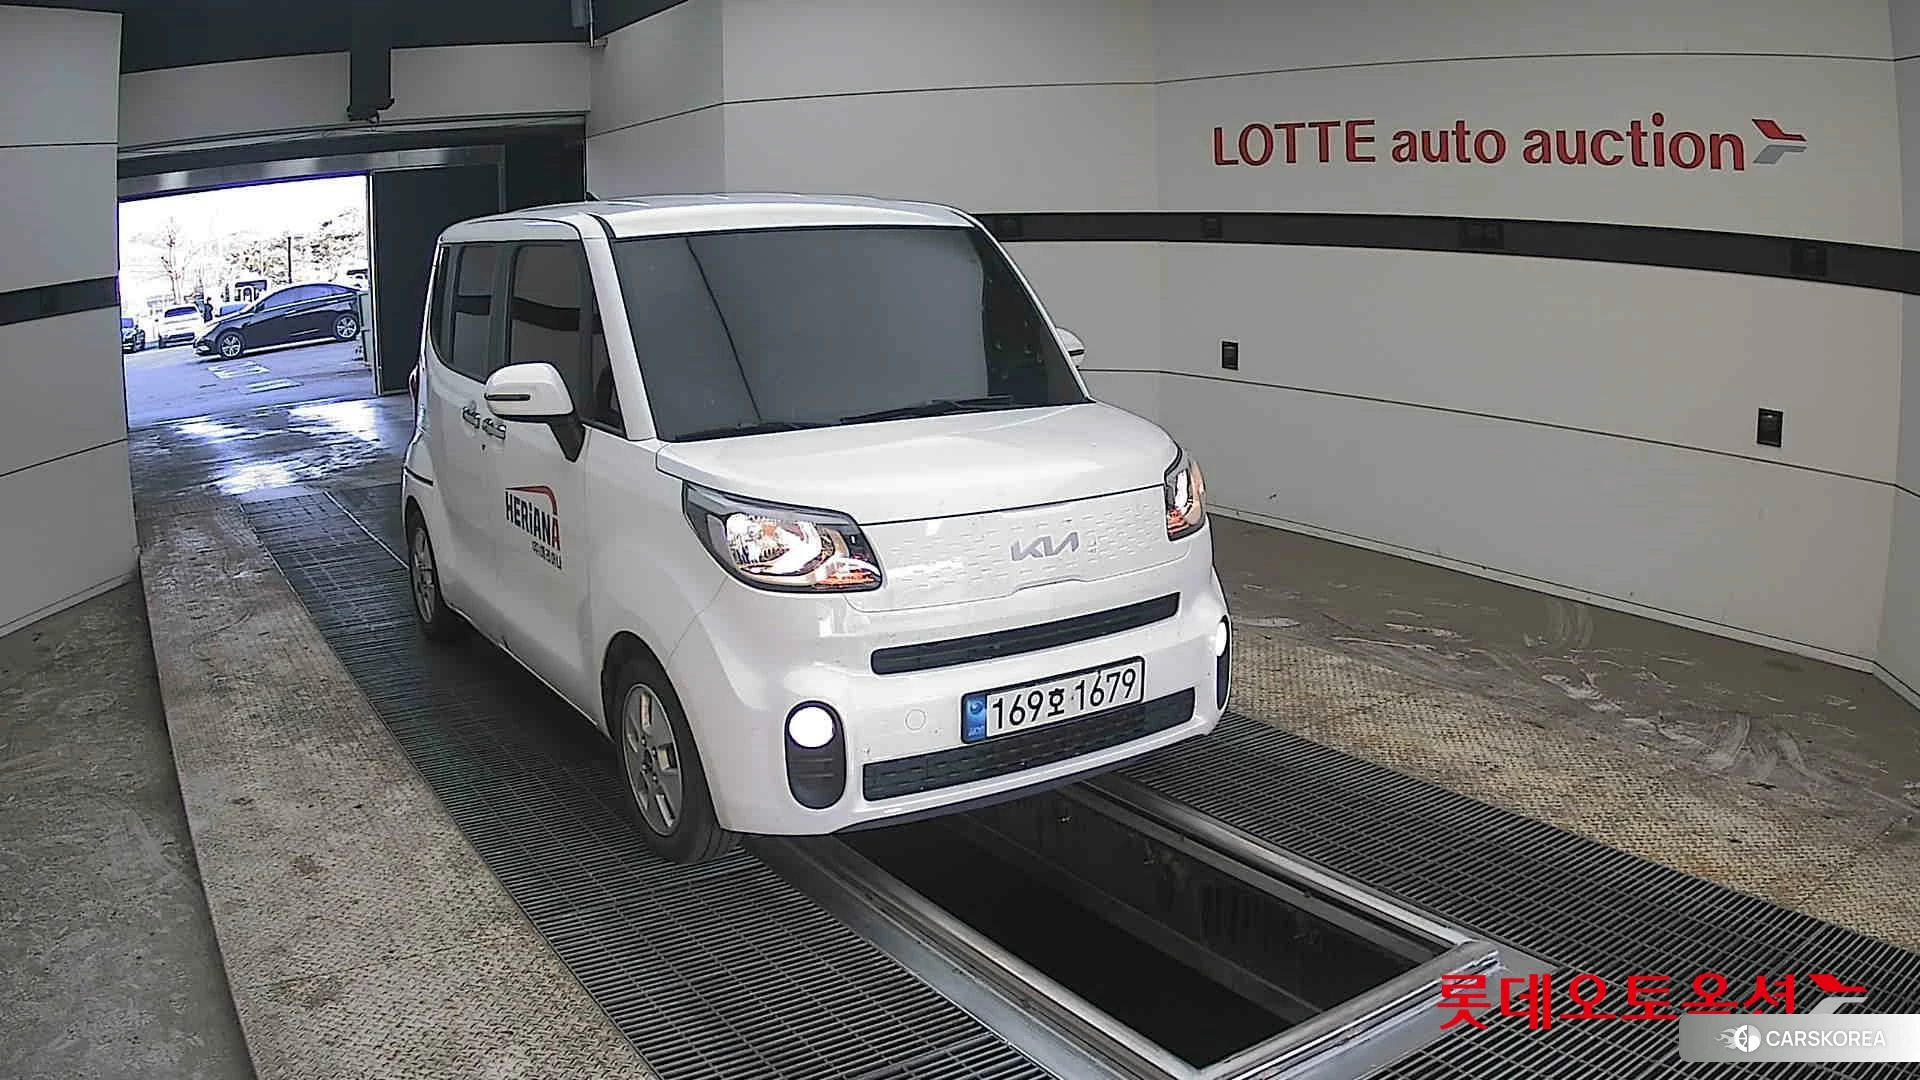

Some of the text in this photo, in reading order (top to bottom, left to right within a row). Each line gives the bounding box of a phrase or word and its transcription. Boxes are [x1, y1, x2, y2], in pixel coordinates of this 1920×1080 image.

[1213, 112, 1745, 171] LOTTE auto auction
